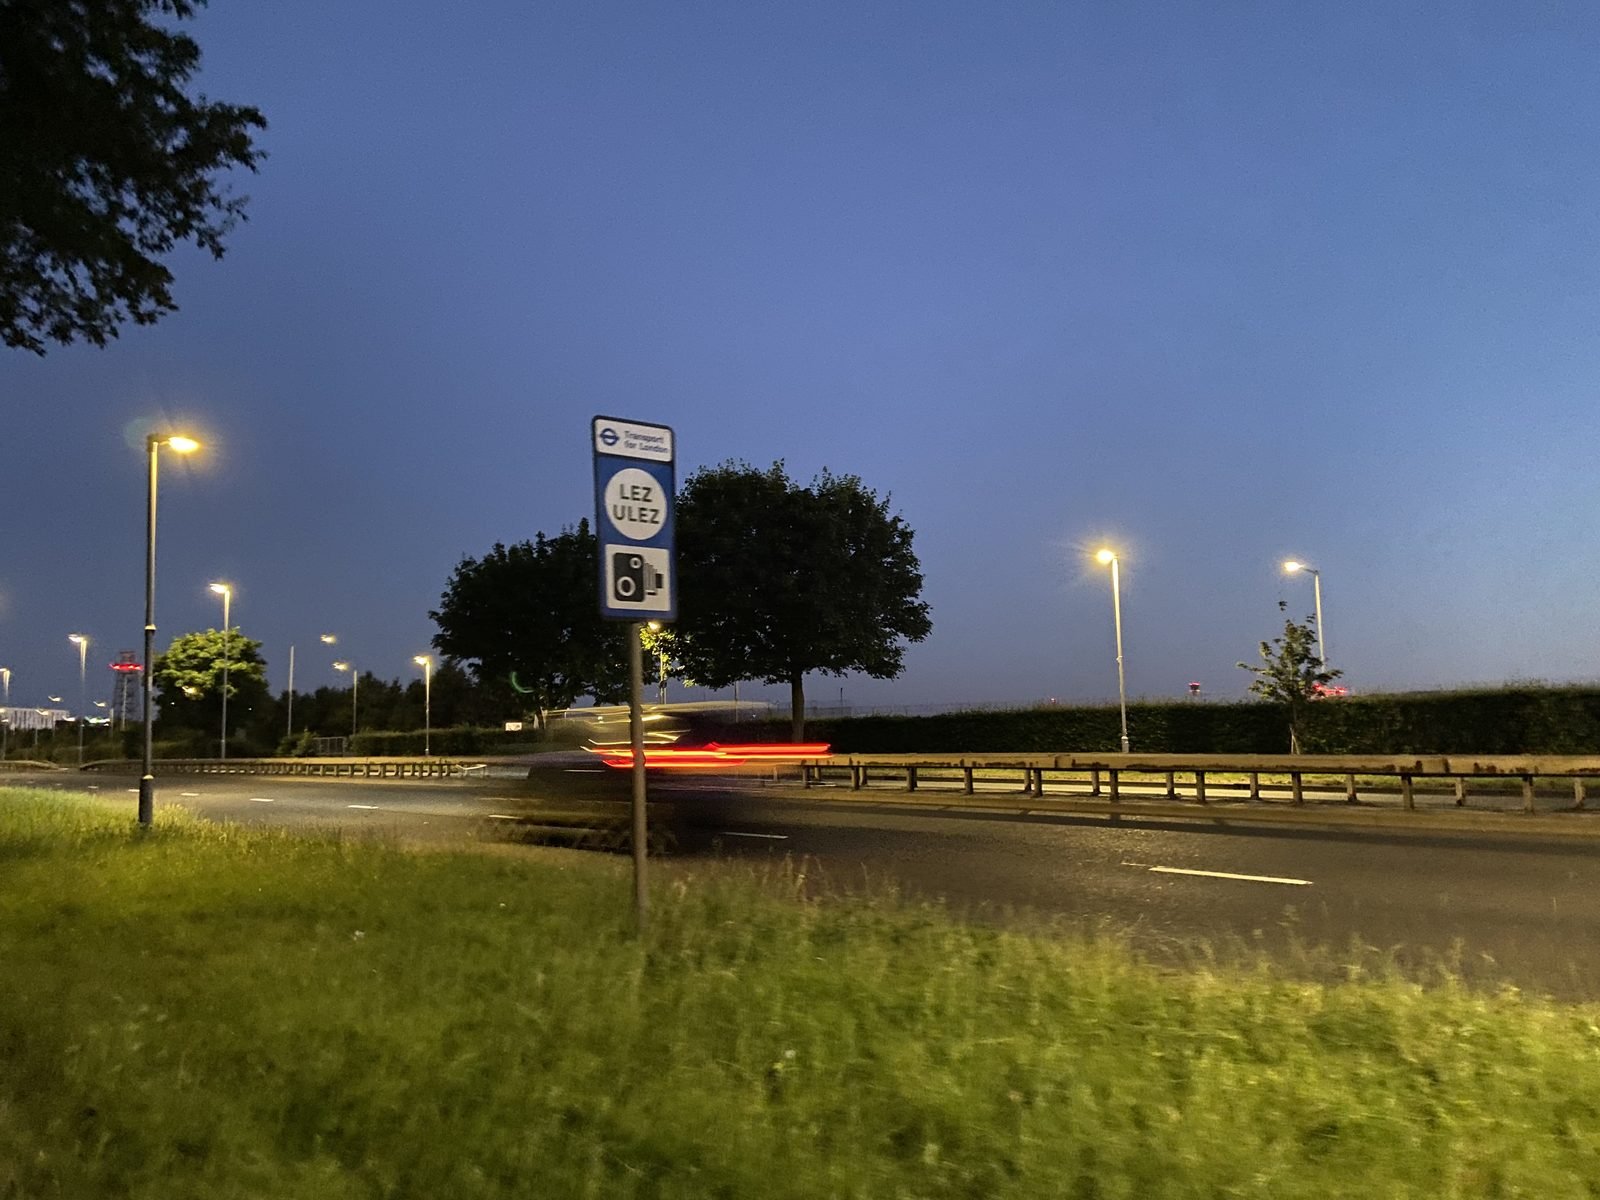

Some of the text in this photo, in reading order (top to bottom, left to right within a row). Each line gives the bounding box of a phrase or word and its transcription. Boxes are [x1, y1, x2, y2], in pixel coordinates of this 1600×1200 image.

[624, 431, 664, 443] Transport
[624, 440, 668, 453] for London
[620, 483, 653, 503] LEZ
[613, 504, 660, 524] ULEZ
